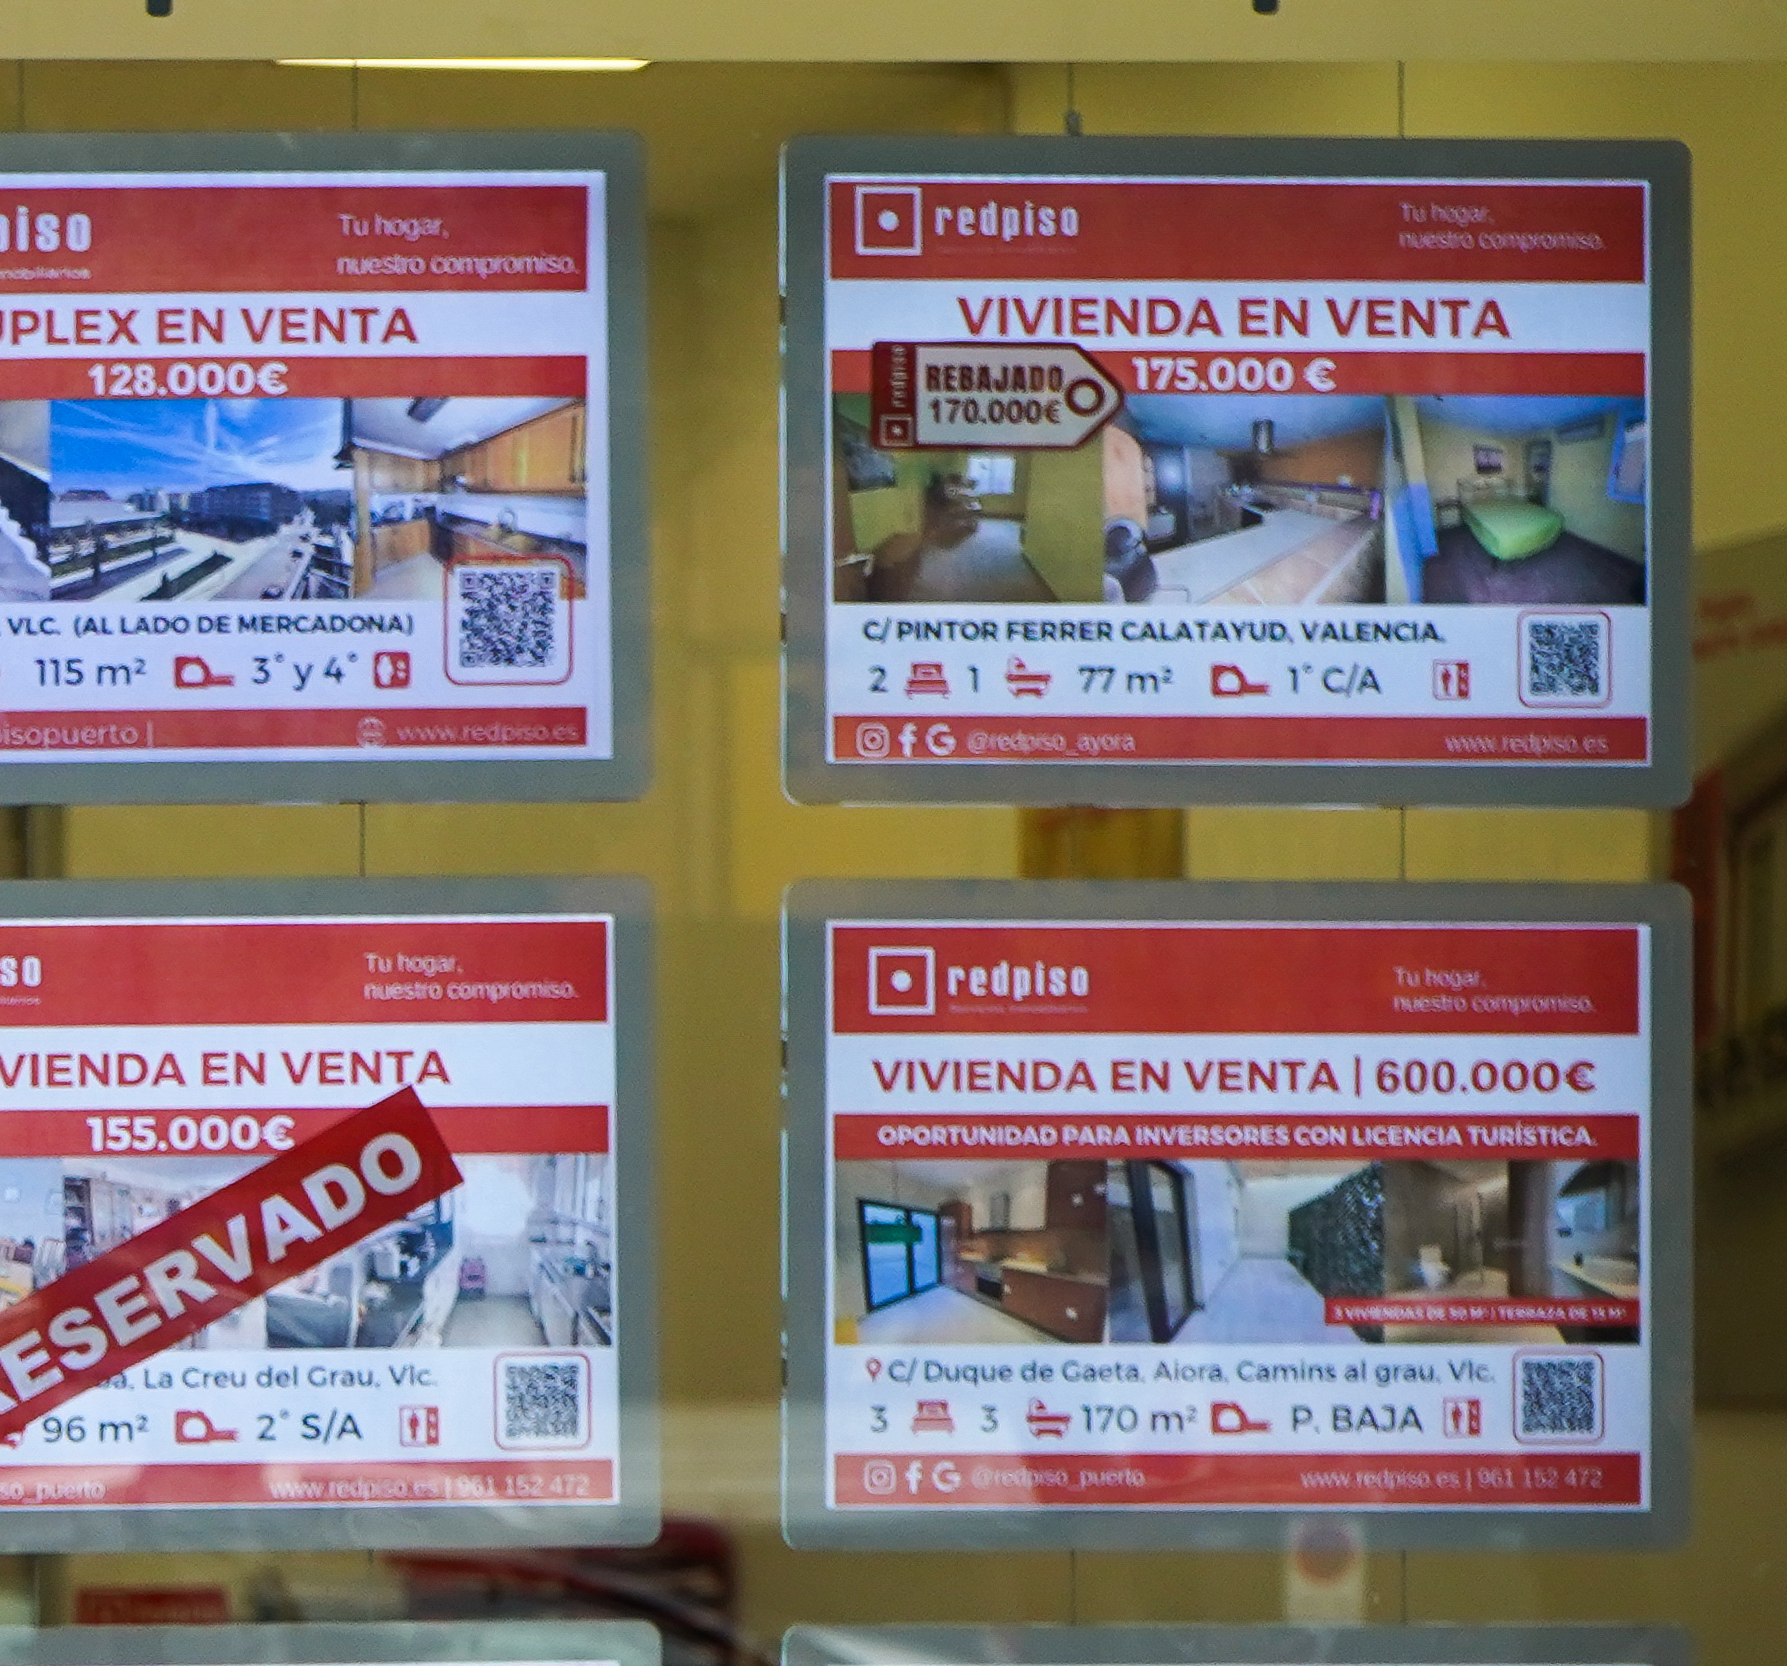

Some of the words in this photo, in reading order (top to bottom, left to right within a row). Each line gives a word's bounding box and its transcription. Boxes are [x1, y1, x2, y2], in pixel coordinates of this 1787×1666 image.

[156, 308, 225, 345] EN
[240, 307, 418, 344] VENTA
[954, 297, 1222, 338] VIVIENDA
[1238, 298, 1309, 337] EN
[1325, 298, 1511, 338] VENTA
[88, 361, 288, 401] 128.000€
[925, 364, 1069, 398] REBAJADO
[1131, 357, 1296, 393] 175.000
[1304, 357, 1338, 393] €
[929, 397, 1060, 425] 170.000€
[201, 1051, 266, 1086] EN
[281, 1050, 451, 1086] VENTA
[872, 1060, 1097, 1092] VIVIENDA
[1111, 1060, 1170, 1093] EN
[1183, 1060, 1340, 1093] VENTA
[1376, 1059, 1596, 1094] 600.000€
[86, 1115, 295, 1152] 155.000€
